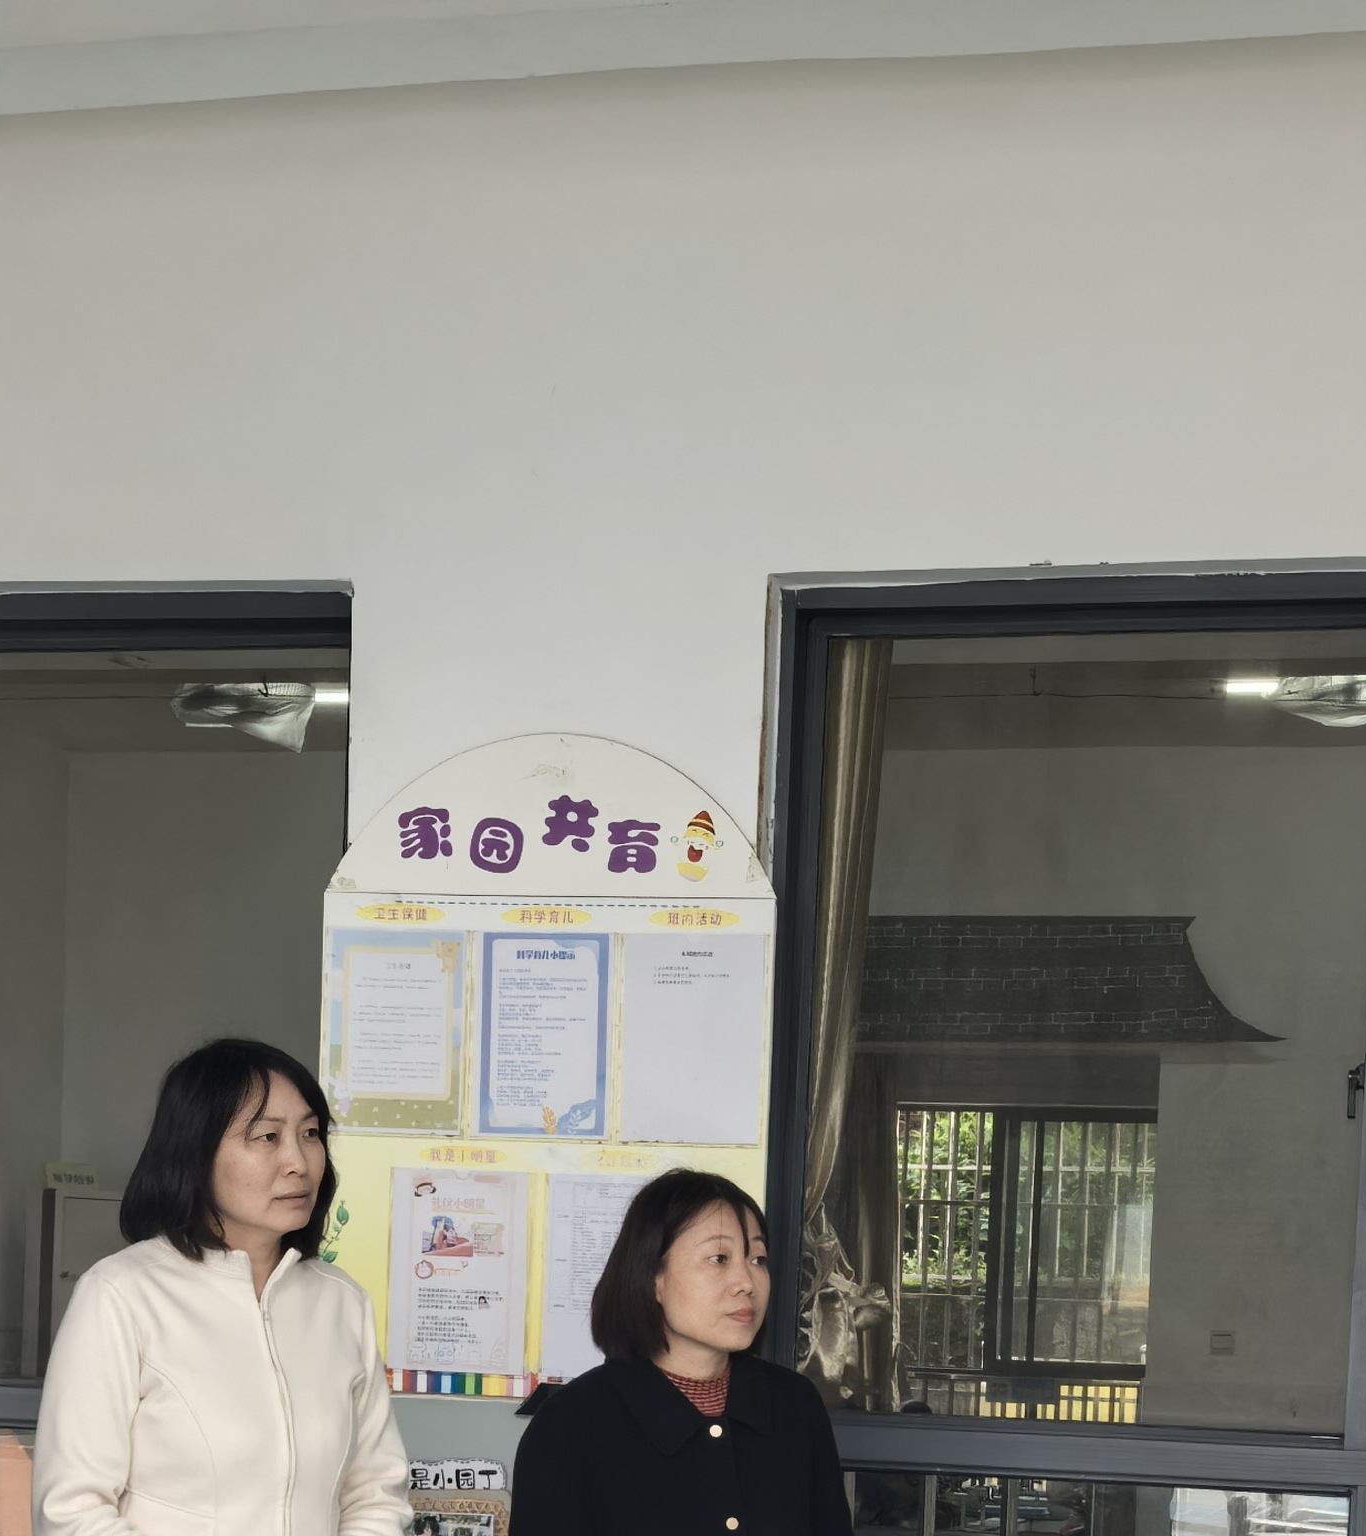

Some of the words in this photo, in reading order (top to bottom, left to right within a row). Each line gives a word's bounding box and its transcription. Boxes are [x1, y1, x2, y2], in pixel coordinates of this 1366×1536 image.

[398, 795, 661, 874] 家园共育
[374, 907, 428, 922] 卫生保健
[519, 909, 574, 925] 科学育儿
[667, 912, 722, 927] 班内活动
[410, 1468, 498, 1490] 是小园丁
